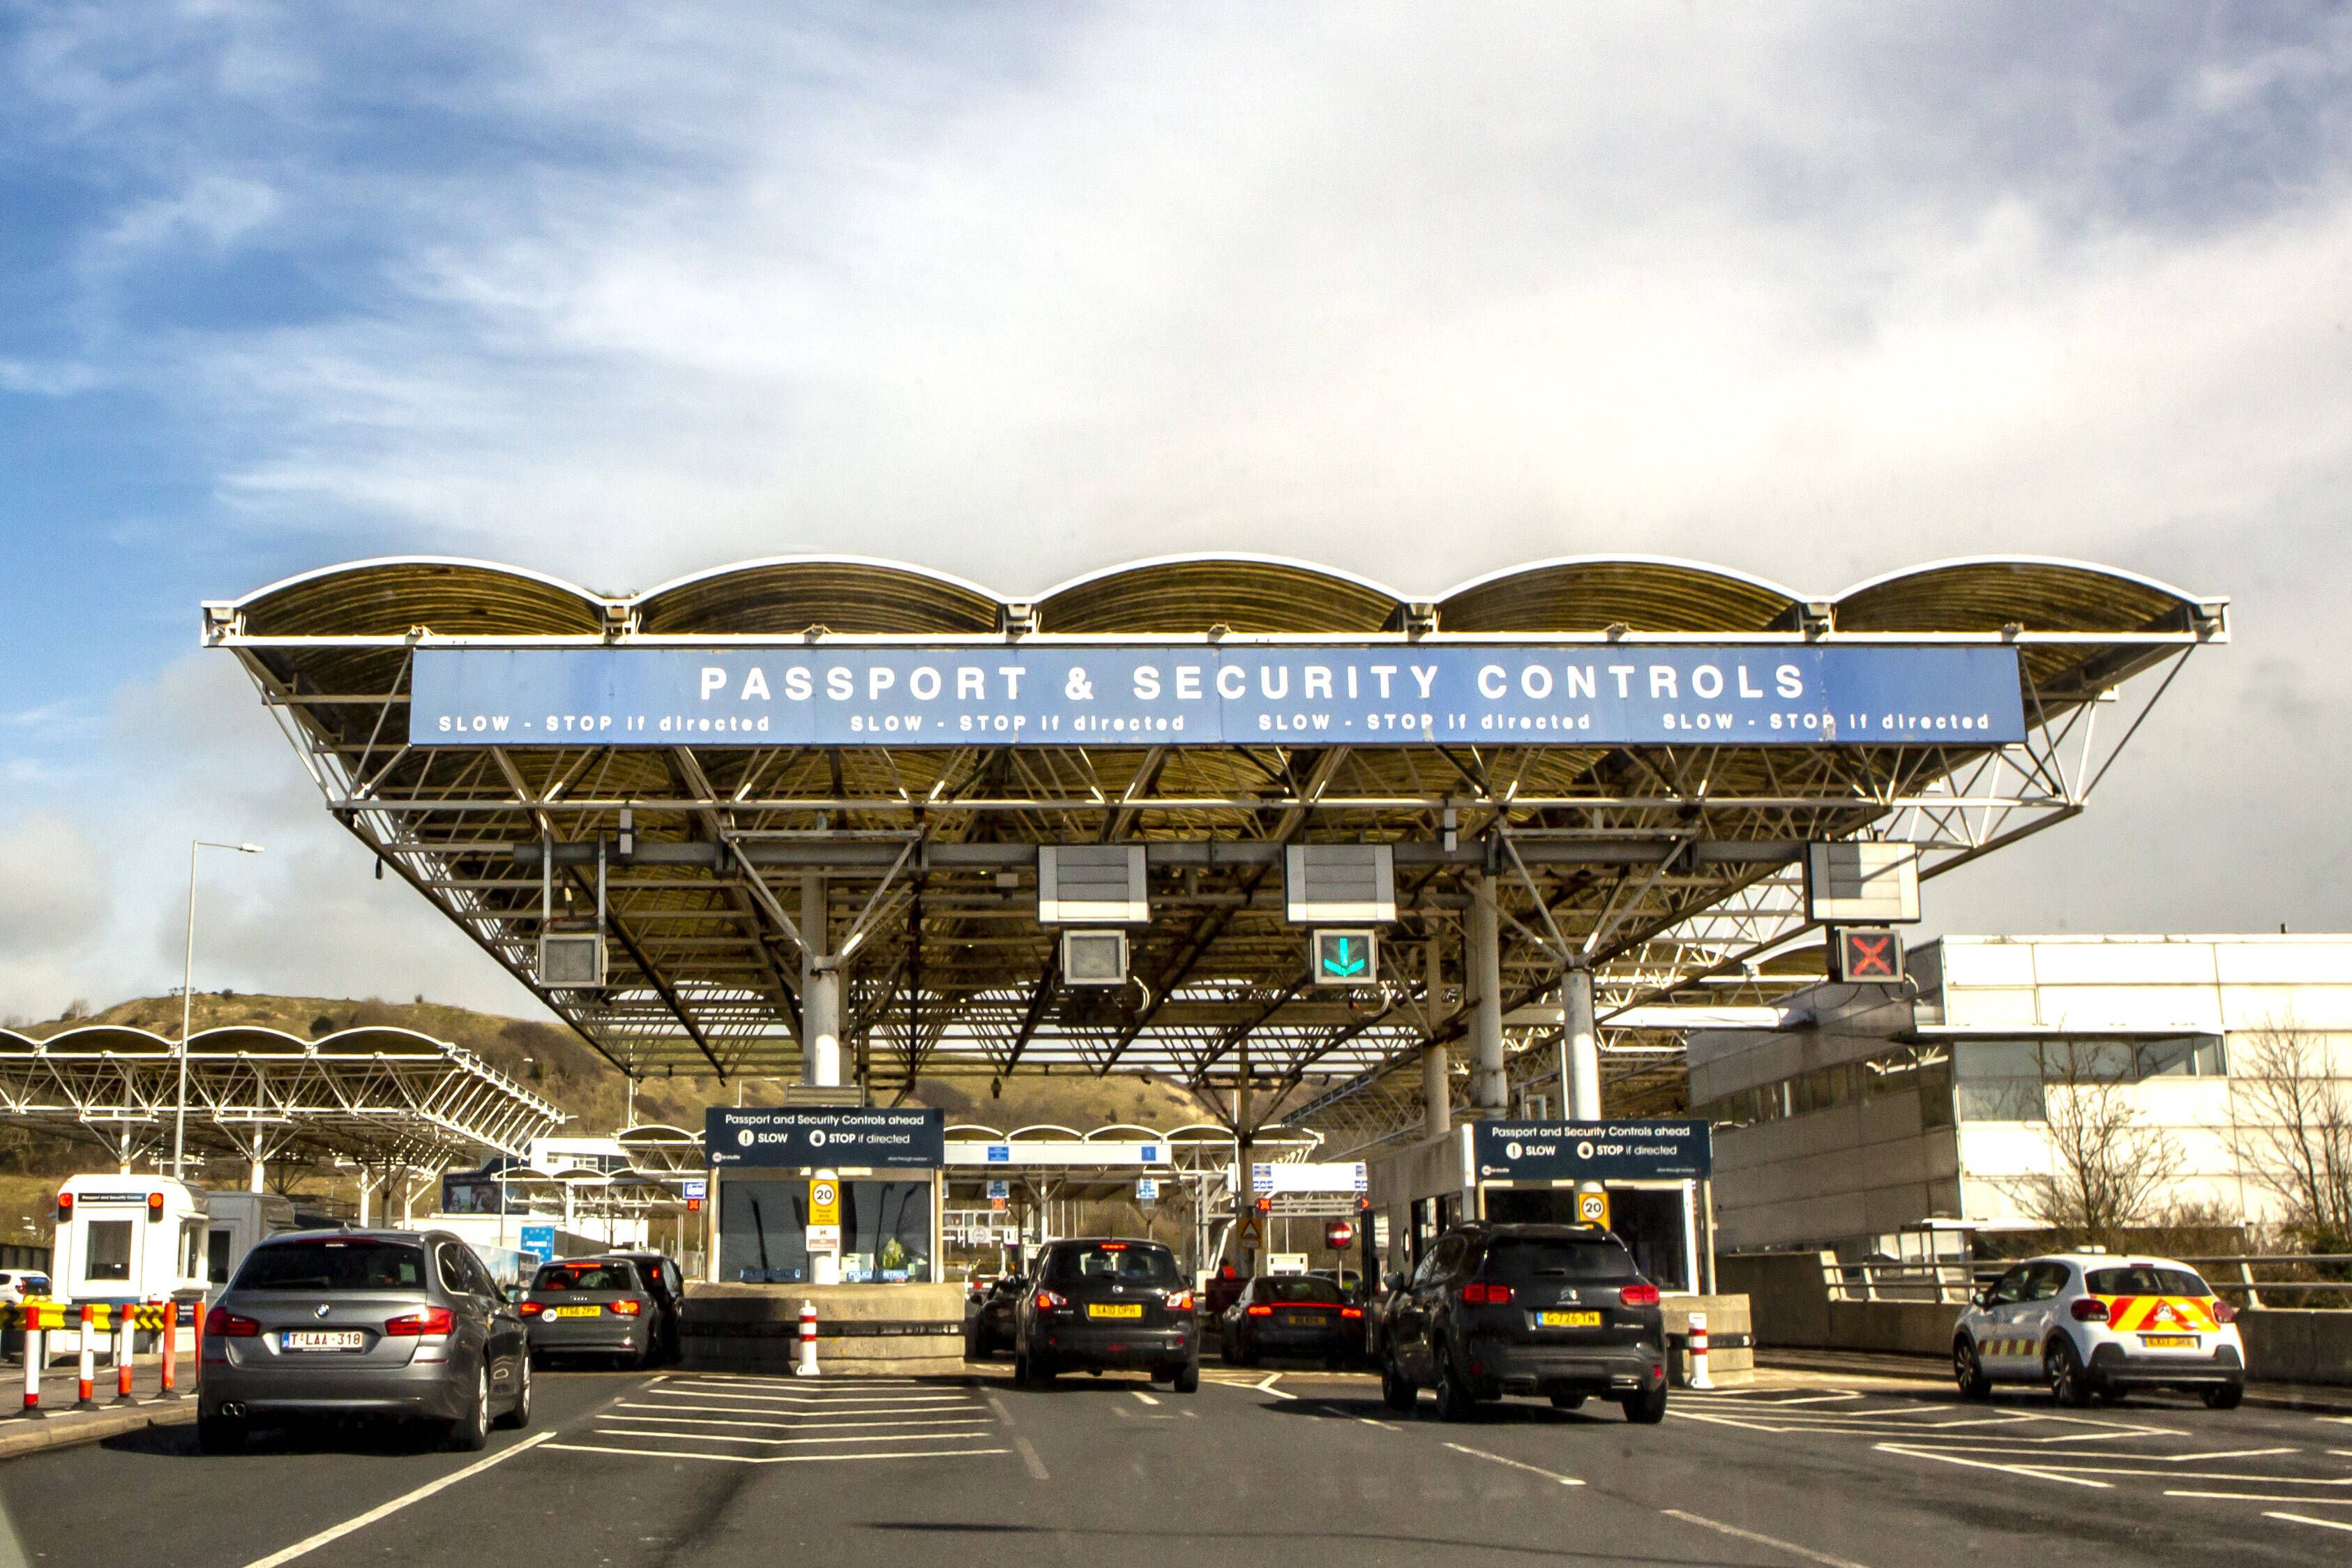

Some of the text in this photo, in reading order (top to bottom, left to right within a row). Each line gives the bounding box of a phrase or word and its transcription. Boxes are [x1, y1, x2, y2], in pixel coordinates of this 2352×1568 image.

[701, 665, 1803, 701] PASSPORT & SECURITY CONTROLS
[439, 716, 509, 732] SLOW
[546, 715, 612, 732] STOP
[627, 716, 644, 730] if
[659, 716, 769, 732] directed
[851, 715, 922, 731] SLOW
[960, 715, 1026, 731] STOP
[1041, 715, 1059, 730] if
[1074, 715, 1184, 731] directed
[1259, 714, 1329, 730] SLOW
[1367, 714, 1433, 730] STOP
[1449, 714, 1466, 729] if
[1481, 714, 1590, 730] directed
[1663, 714, 1733, 730] SLOW
[1770, 714, 1835, 730] STOP
[1850, 714, 1867, 728] if
[1882, 714, 1989, 729] directed
[725, 1114, 924, 1126] Passport and Security Controls ahead
[1492, 1126, 1690, 1138] Passport and Security Controls ahead
[757, 1133, 788, 1143] SLOW
[829, 1133, 910, 1143] STOP if directed
[1525, 1145, 1556, 1156] SLOW
[1597, 1145, 1678, 1155] STOP if directed
[816, 1189, 832, 1200] 20
[1584, 1203, 1602, 1213] 20
[848, 1271, 873, 1279] POLICE
